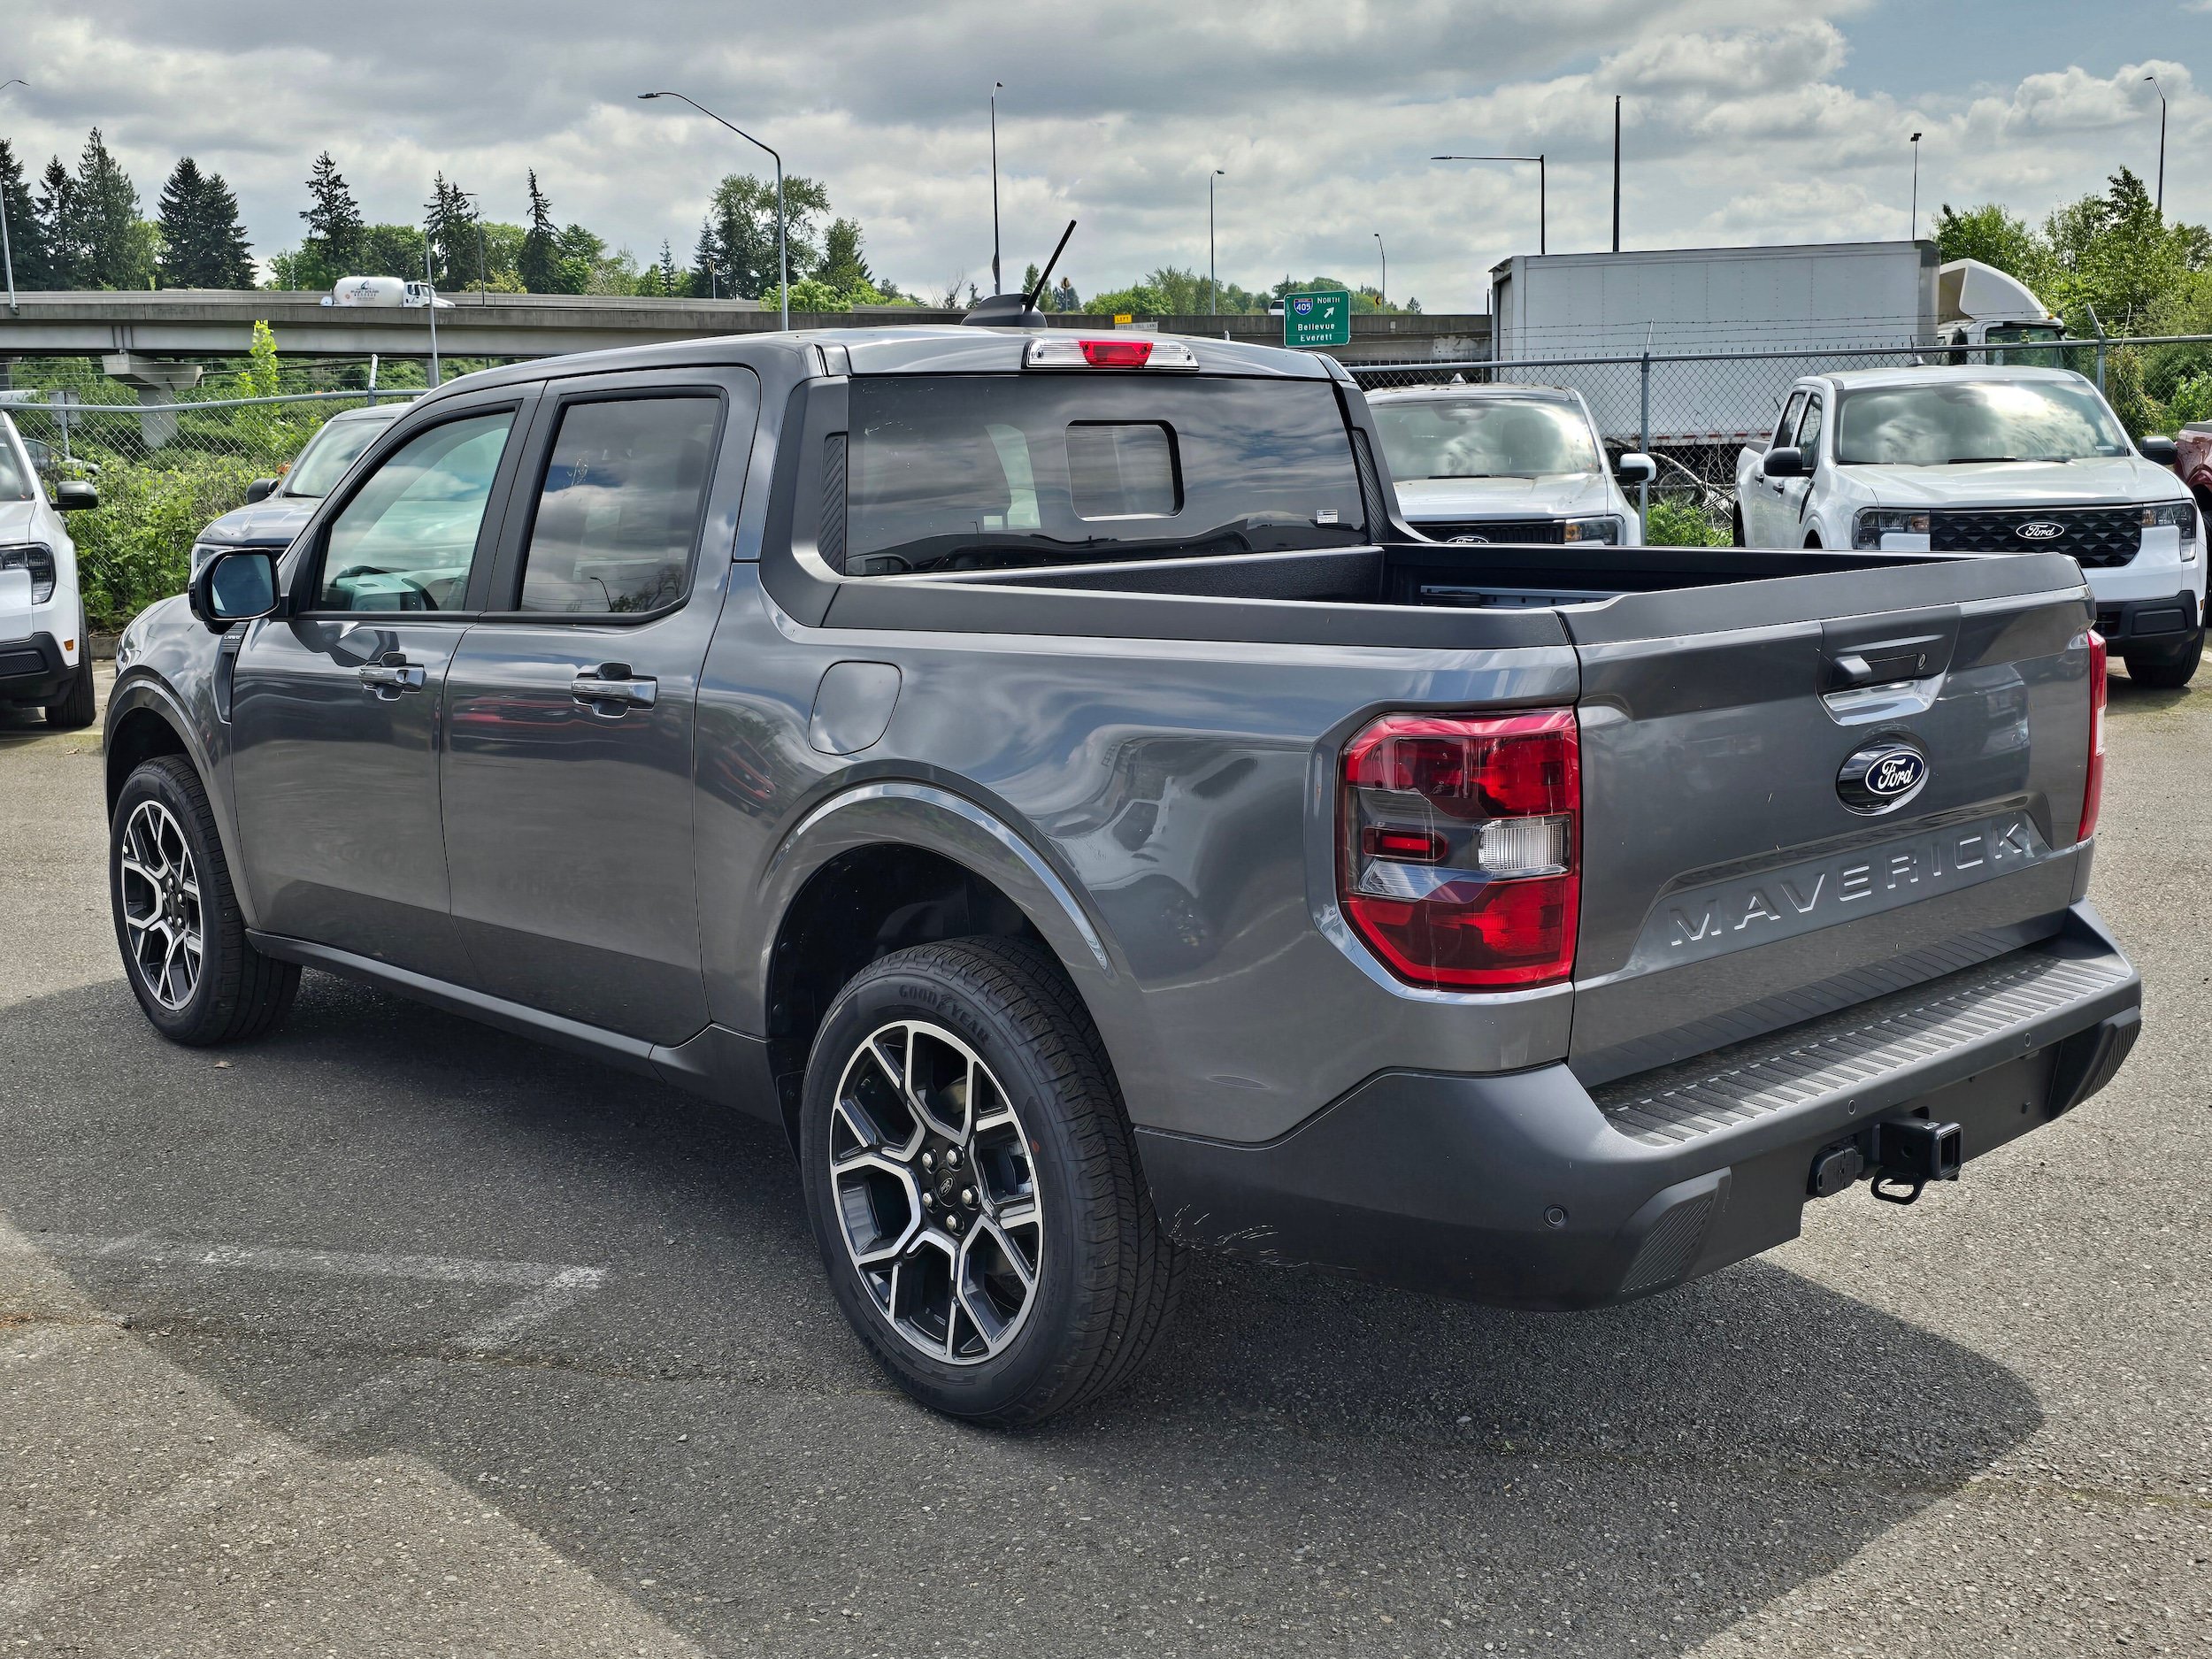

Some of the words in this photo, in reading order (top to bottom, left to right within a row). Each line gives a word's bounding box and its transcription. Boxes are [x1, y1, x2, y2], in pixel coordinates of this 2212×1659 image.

[1300, 334, 1333, 342] Everett
[2025, 524, 2055, 536] Ford
[1878, 757, 1914, 790] Ford
[1669, 822, 2023, 946] MAVERICK
[898, 983, 990, 1045] GOODYEAR
